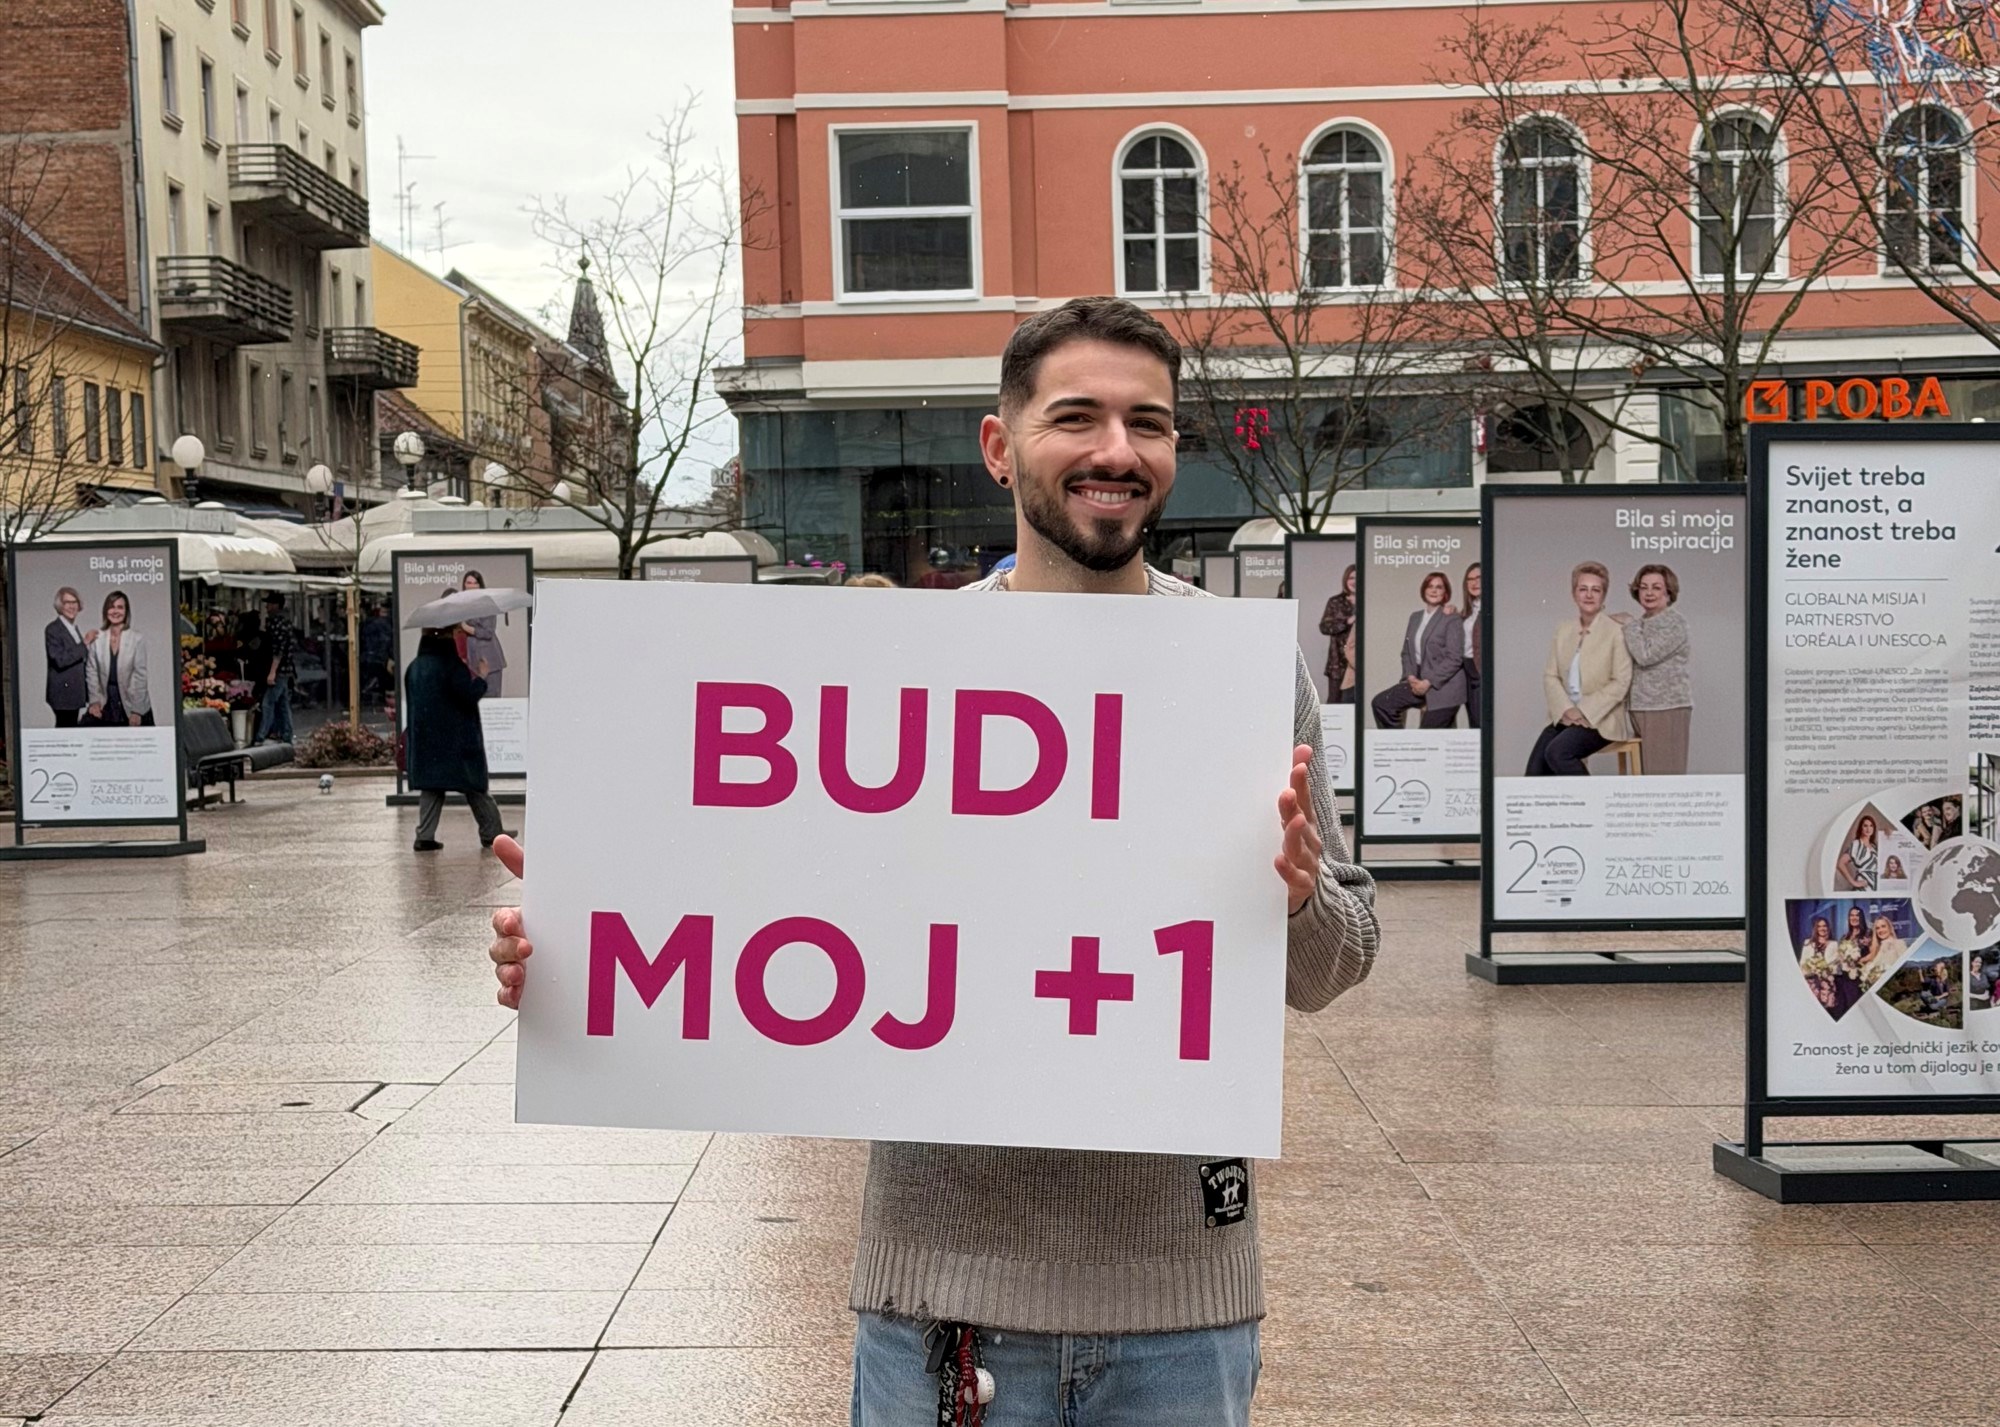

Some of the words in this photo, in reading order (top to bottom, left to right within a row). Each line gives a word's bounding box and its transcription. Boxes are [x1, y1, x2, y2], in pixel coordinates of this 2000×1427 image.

[1805, 377, 1951, 421] POBA
[1786, 465, 1852, 491] Svijet
[1859, 465, 1925, 486] treba
[1786, 495, 1889, 515] znanost,
[1898, 499, 1912, 513] a
[1615, 509, 1654, 528] Bila
[1660, 510, 1676, 528] si
[1682, 509, 1734, 532] moja
[1786, 522, 1883, 541] znanost
[1890, 519, 1956, 541] treba
[1373, 535, 1402, 549] Bila
[1406, 535, 1418, 549] si
[1422, 535, 1461, 552] moja
[1630, 531, 1734, 554] inspiracija
[89, 556, 114, 570] Bila
[117, 556, 128, 569] si
[130, 555, 164, 572] moja
[1245, 556, 1265, 566] Bila
[1266, 556, 1276, 566] si
[1374, 551, 1450, 568] inspiracija
[1786, 548, 1842, 568] žene
[404, 562, 424, 573] Bila
[427, 562, 435, 573] si
[437, 562, 465, 574] moja
[650, 567, 667, 576] Bila
[669, 567, 677, 576] si
[678, 568, 701, 577] moja
[1245, 567, 1285, 578] inspirac
[98, 570, 164, 585] inspiracija
[404, 573, 458, 585] inspiracija
[1785, 592, 1868, 606] GLOBALNA
[1872, 592, 1919, 605] MISIJA
[1922, 592, 1926, 605] I
[1785, 613, 1895, 626] PARTNERSTVO
[1785, 632, 1857, 647] L'ORÉALA
[1859, 635, 1864, 646] I
[1868, 634, 1947, 647] UNESCO-A
[692, 681, 1123, 820] BUDI
[1445, 793, 1461, 805] ZA
[1464, 792, 1478, 805] ŽE
[1445, 806, 1479, 818] ZNAN
[1605, 864, 1627, 879] ZA
[1632, 862, 1673, 879] ŽENE
[1678, 864, 1691, 878] U
[1605, 881, 1687, 896] ZNANOSTI
[1692, 880, 1732, 895] 2026.
[587, 911, 959, 1051] MOJ
[1035, 920, 1215, 1062] +1
[1793, 1043, 1854, 1056] Znanost
[1856, 1043, 1869, 1058] je
[1873, 1041, 1943, 1058] zajednički
[1946, 1041, 1978, 1057] jezik
[1835, 1062, 1870, 1075] žena
[1874, 1064, 1883, 1074] u
[1887, 1062, 1916, 1074] tom
[1920, 1061, 1976, 1076] dijalogu
[1980, 1061, 1993, 1075] je
